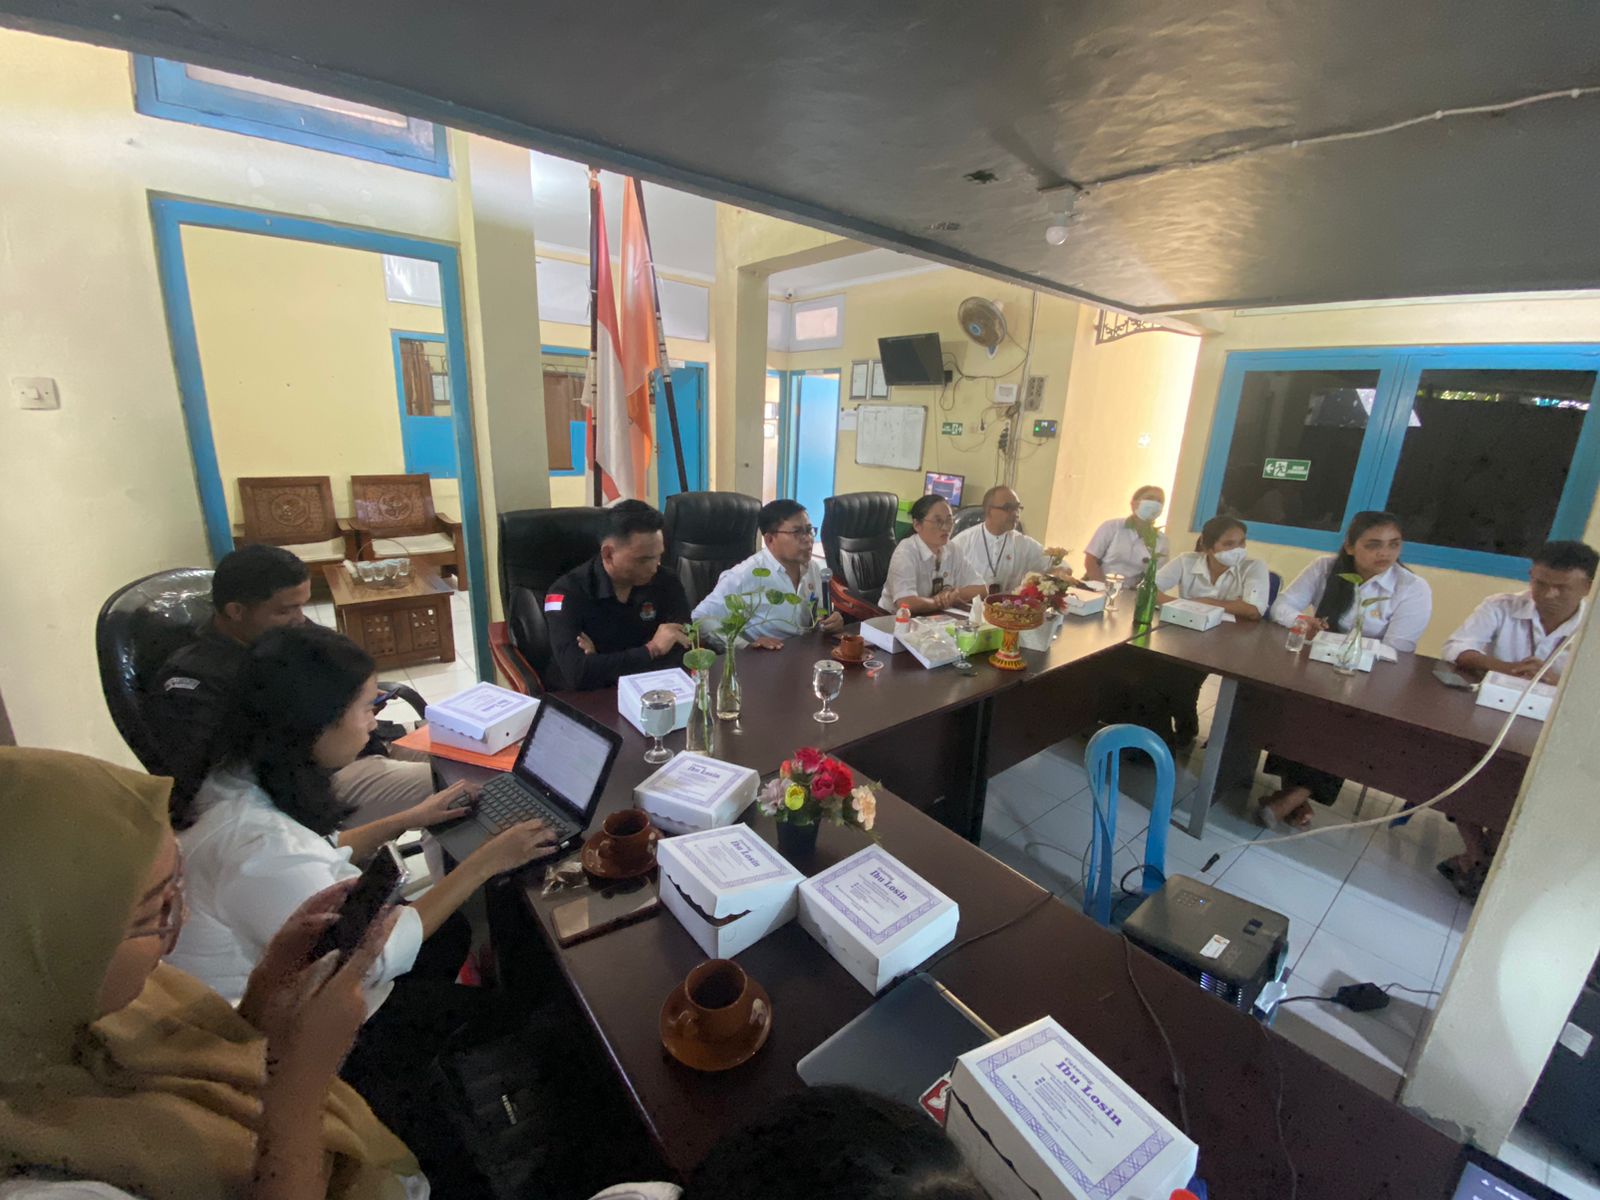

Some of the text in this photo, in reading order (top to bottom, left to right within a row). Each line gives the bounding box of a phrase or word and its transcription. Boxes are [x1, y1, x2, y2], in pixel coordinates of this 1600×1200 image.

[870, 870, 885, 883] Ibu
[884, 881, 908, 901] Losin
[1056, 1061, 1080, 1085] Ibu
[1081, 1084, 1122, 1127] Losin
